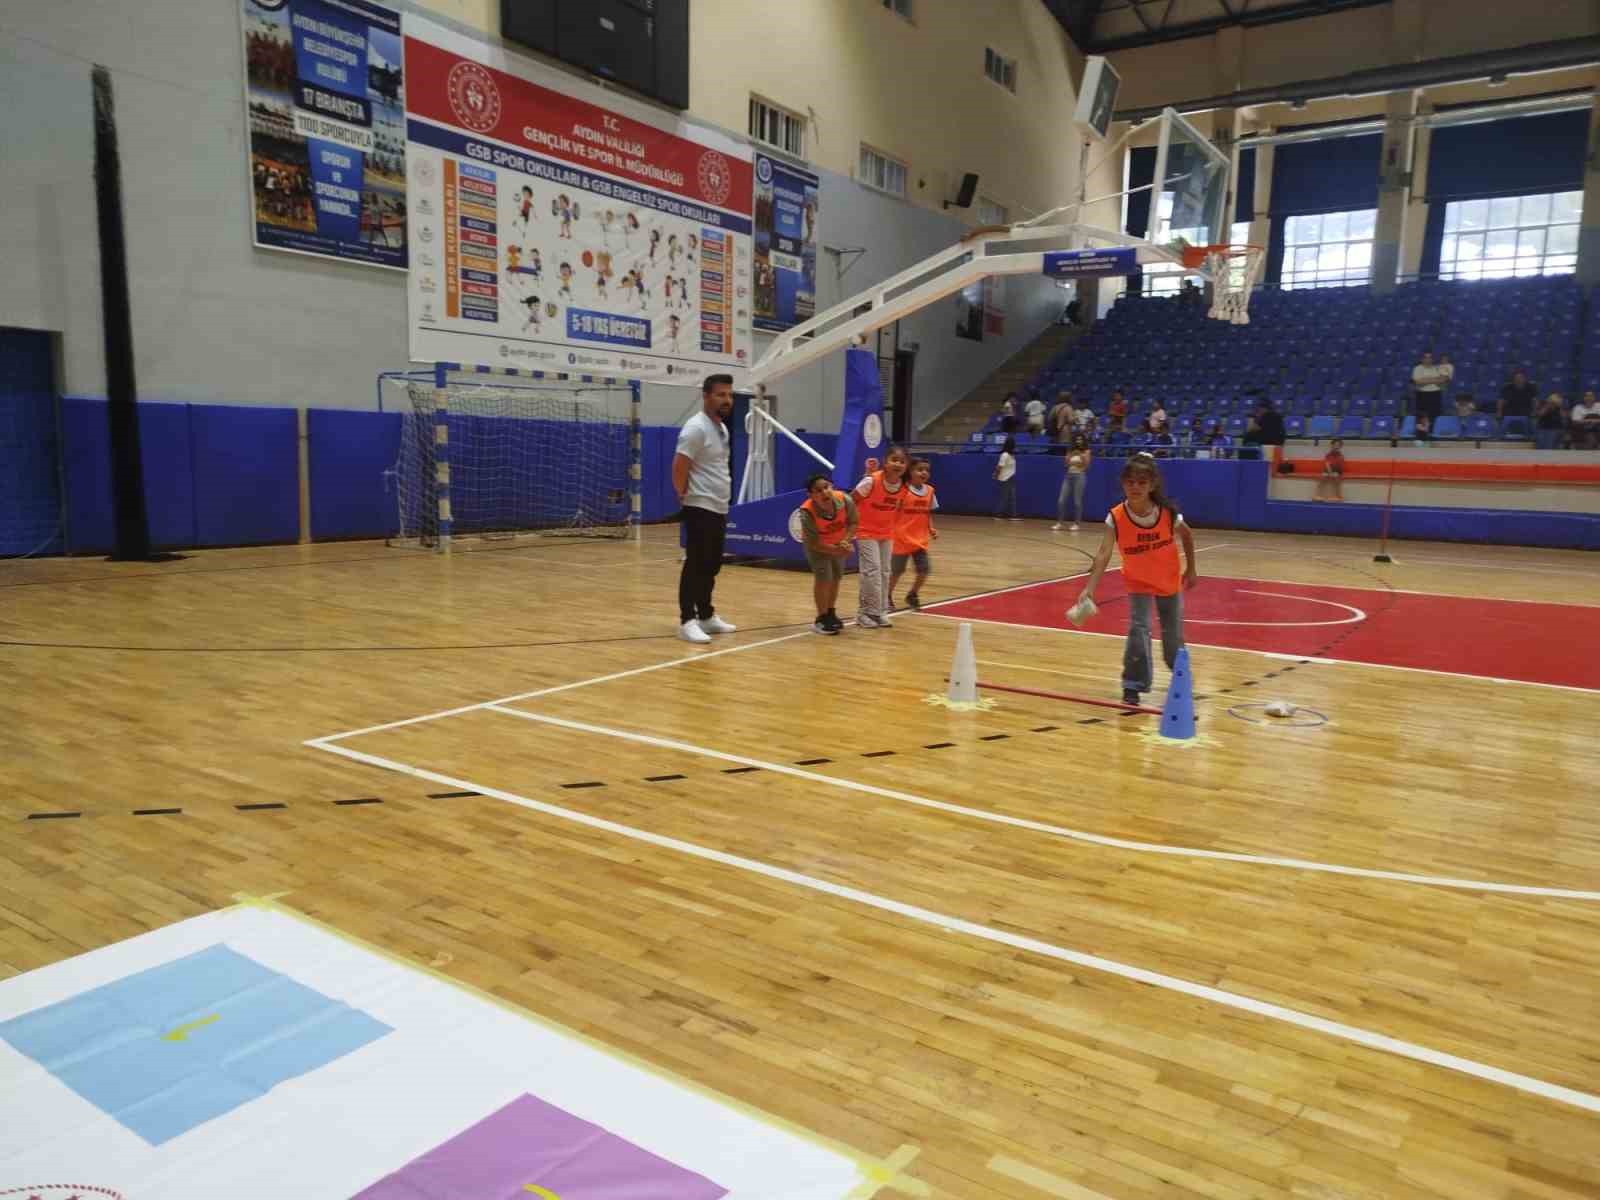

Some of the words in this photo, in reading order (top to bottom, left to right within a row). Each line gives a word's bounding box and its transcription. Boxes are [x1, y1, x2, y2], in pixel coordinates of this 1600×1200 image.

[572, 124, 604, 147] AYDIN
[602, 115, 621, 132] T.C.
[522, 126, 571, 152] GENÇLİK
[571, 140, 586, 157] VE
[587, 143, 615, 167] SPOR
[626, 158, 684, 187] MÜDÜRLÜĞÜ
[466, 142, 491, 161] GSB
[493, 150, 526, 171] SPOR
[526, 160, 580, 186] OKULLARI
[582, 176, 590, 189] &
[591, 180, 612, 194] GSB
[612, 185, 656, 206] ENGELSİZ
[657, 198, 680, 214] SPOR
[681, 205, 720, 224] OKULLARI
